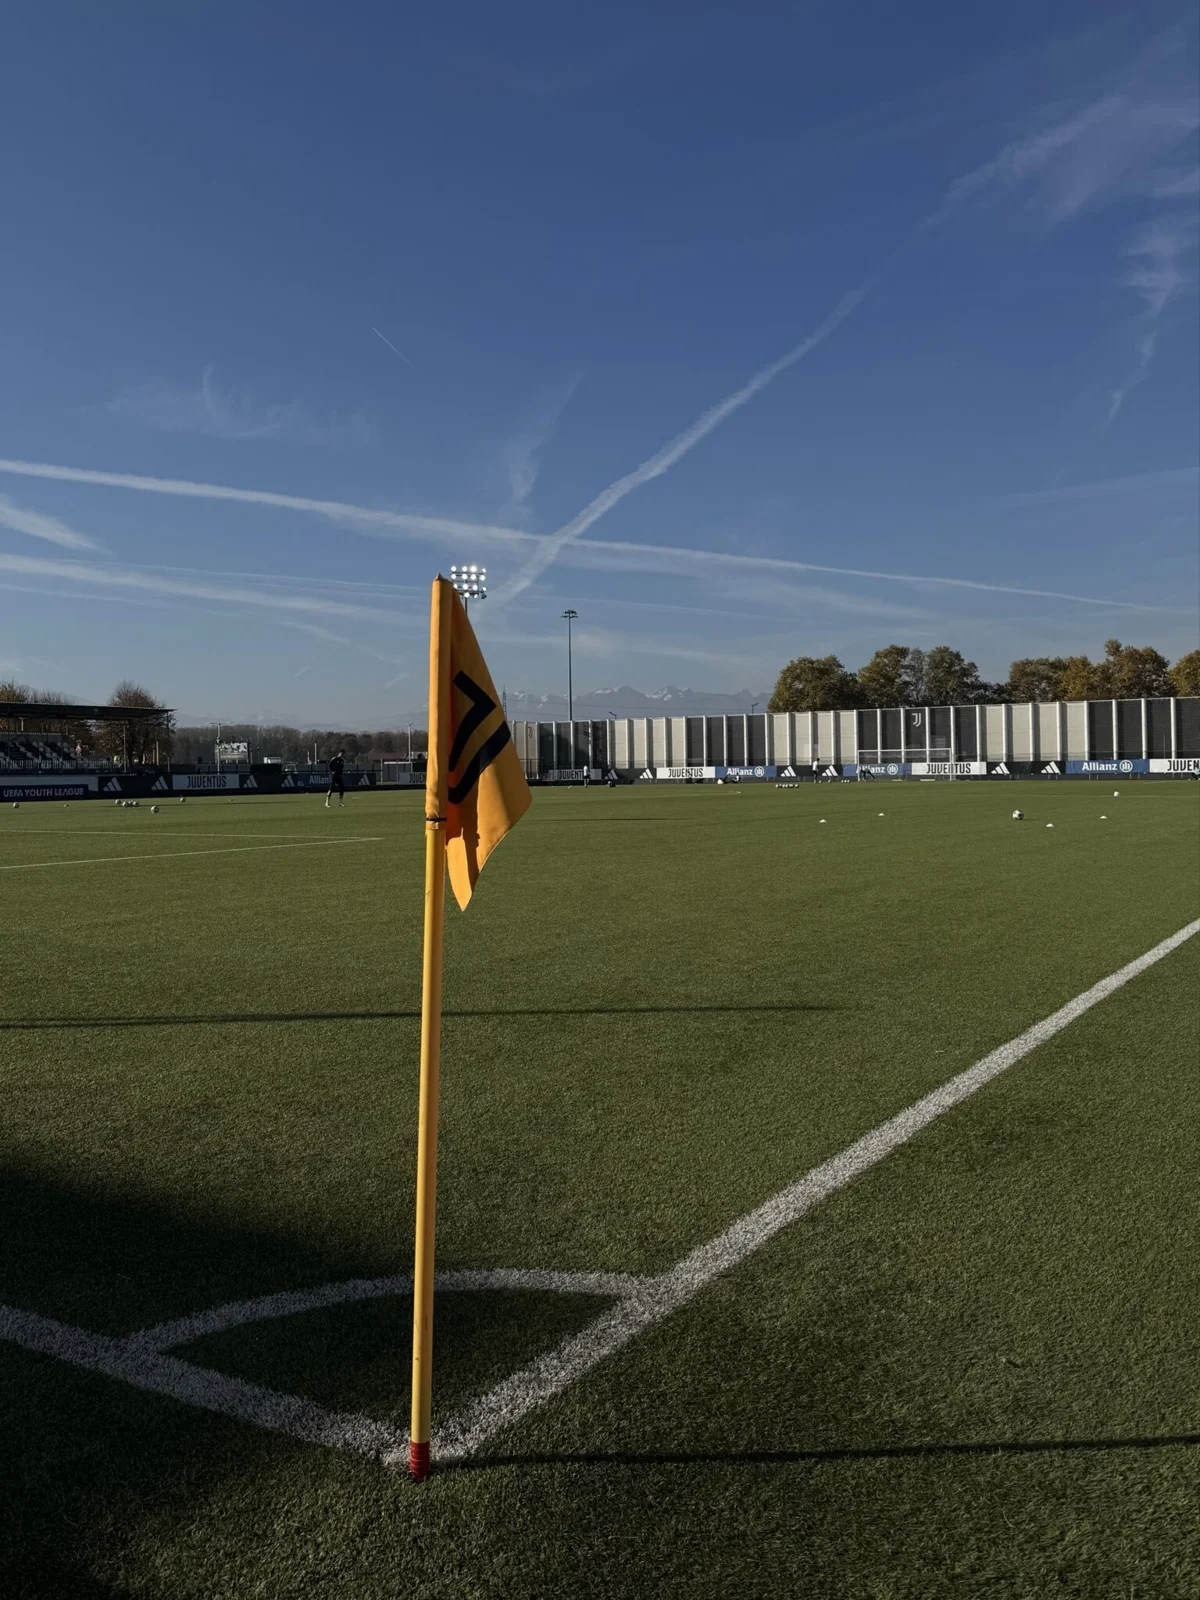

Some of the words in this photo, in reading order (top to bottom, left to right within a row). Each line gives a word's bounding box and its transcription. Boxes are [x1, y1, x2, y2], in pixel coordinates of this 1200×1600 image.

[926, 763, 971, 774] JUVENTUS
[1082, 761, 1117, 771] Allianz
[1167, 759, 1200, 772] JUVEN
[559, 770, 583, 780] JUVENT
[668, 767, 704, 778] JUVENTUS
[187, 775, 227, 788] JUVENTUS
[3, 788, 24, 798] UEFA
[24, 788, 53, 797] YOUTH
[54, 787, 84, 796] LEAGUE
